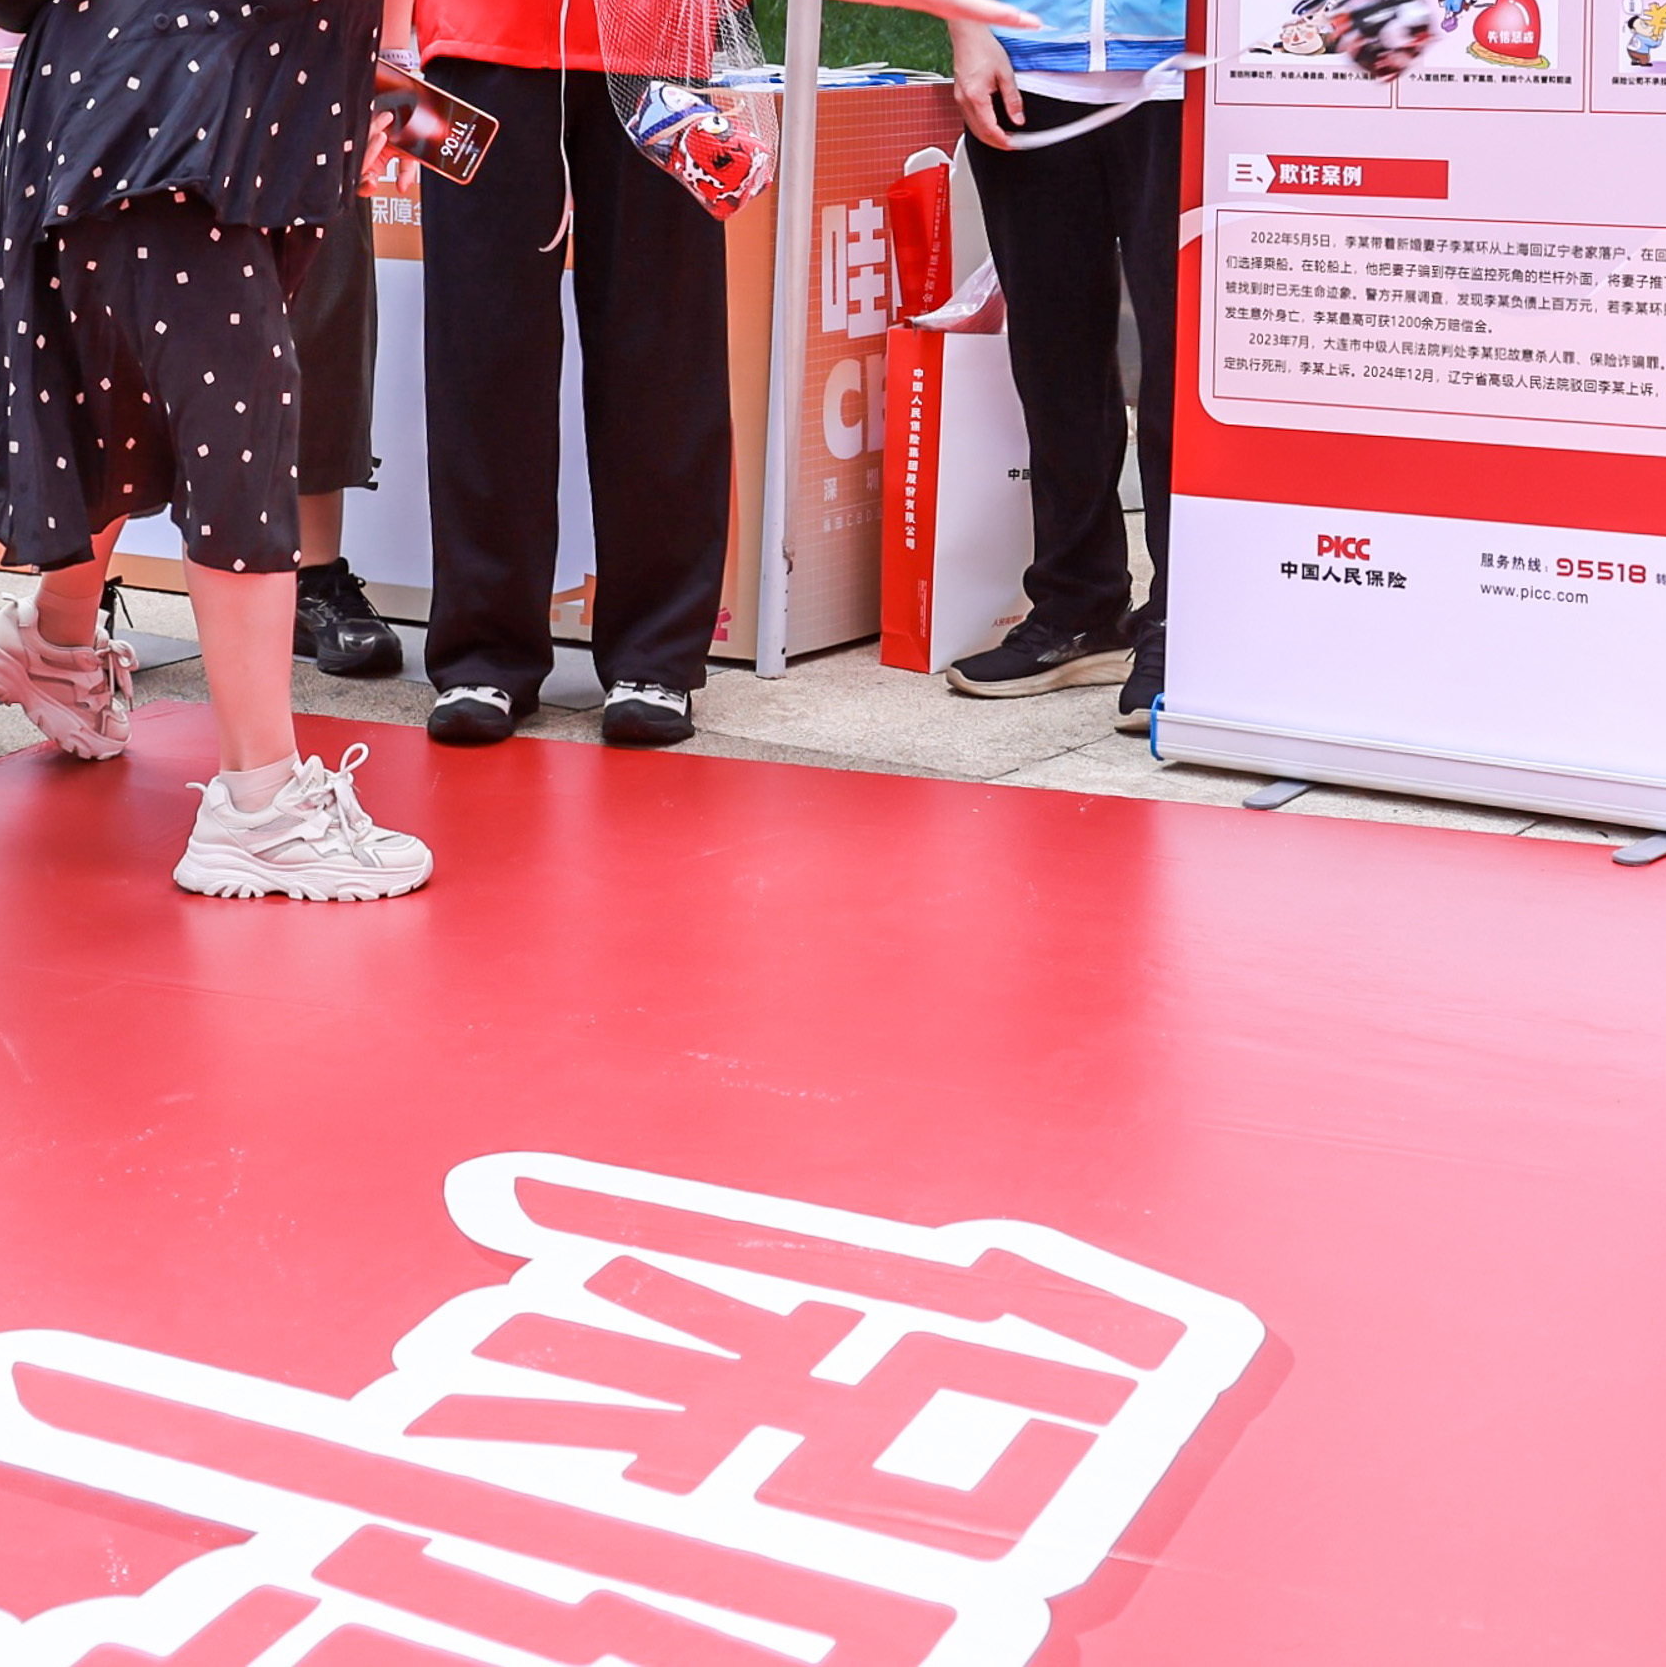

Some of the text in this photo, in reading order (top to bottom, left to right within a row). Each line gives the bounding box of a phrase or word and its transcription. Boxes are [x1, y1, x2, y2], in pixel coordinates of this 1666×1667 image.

[439, 121, 469, 158] 11:06
[904, 366, 924, 551] 中国人民保险集团股份有限公司
[1317, 534, 1371, 561] PICC
[1280, 561, 1408, 590] 中国人民保险
[1555, 558, 1647, 584] 95518
[1480, 582, 1589, 605] www.picc.com
